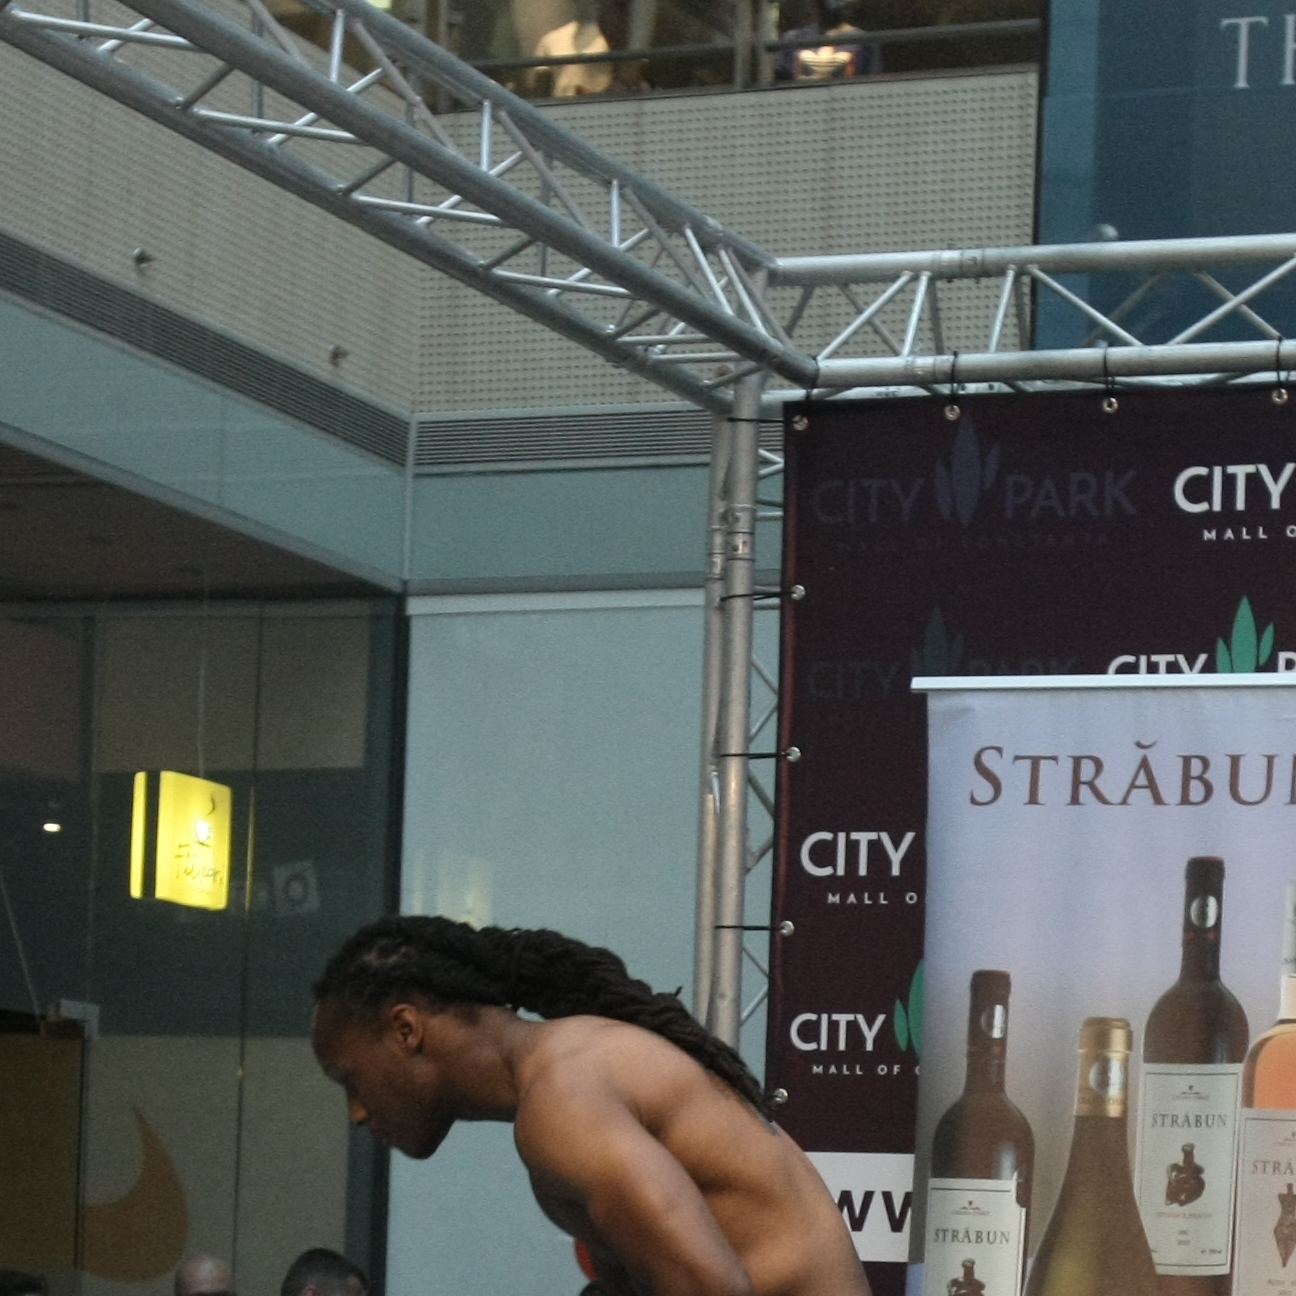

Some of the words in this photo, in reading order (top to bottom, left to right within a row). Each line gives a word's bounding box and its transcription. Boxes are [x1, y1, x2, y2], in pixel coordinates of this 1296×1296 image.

[1173, 462, 1296, 513] CITY
[1203, 526, 1268, 541] MALL
[800, 831, 916, 877] CITY
[827, 892, 888, 904] MALL
[790, 1012, 887, 1051] CITY
[812, 1064, 864, 1075] MALL
[877, 1064, 901, 1075] OF
